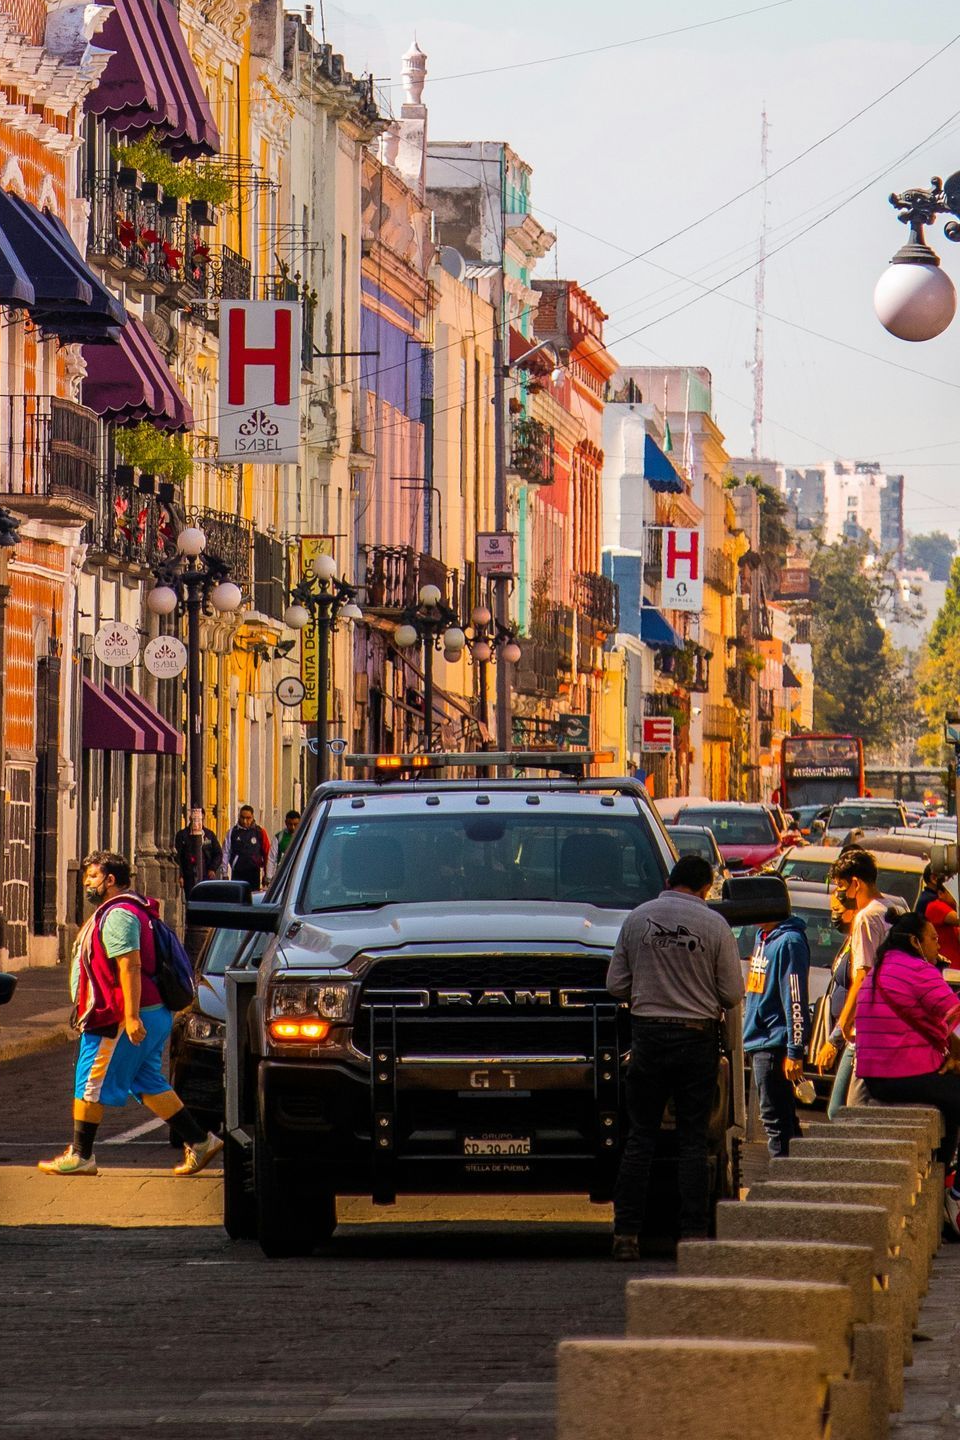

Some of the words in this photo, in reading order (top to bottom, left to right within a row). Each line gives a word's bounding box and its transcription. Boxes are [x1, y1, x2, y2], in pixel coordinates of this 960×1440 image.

[228, 308, 291, 405] H
[667, 530, 699, 580] H
[305, 655, 316, 701] RENTA
[643, 720, 672, 742] E
[437, 991, 551, 1005] RAM
[792, 1002, 803, 1046] adidas
